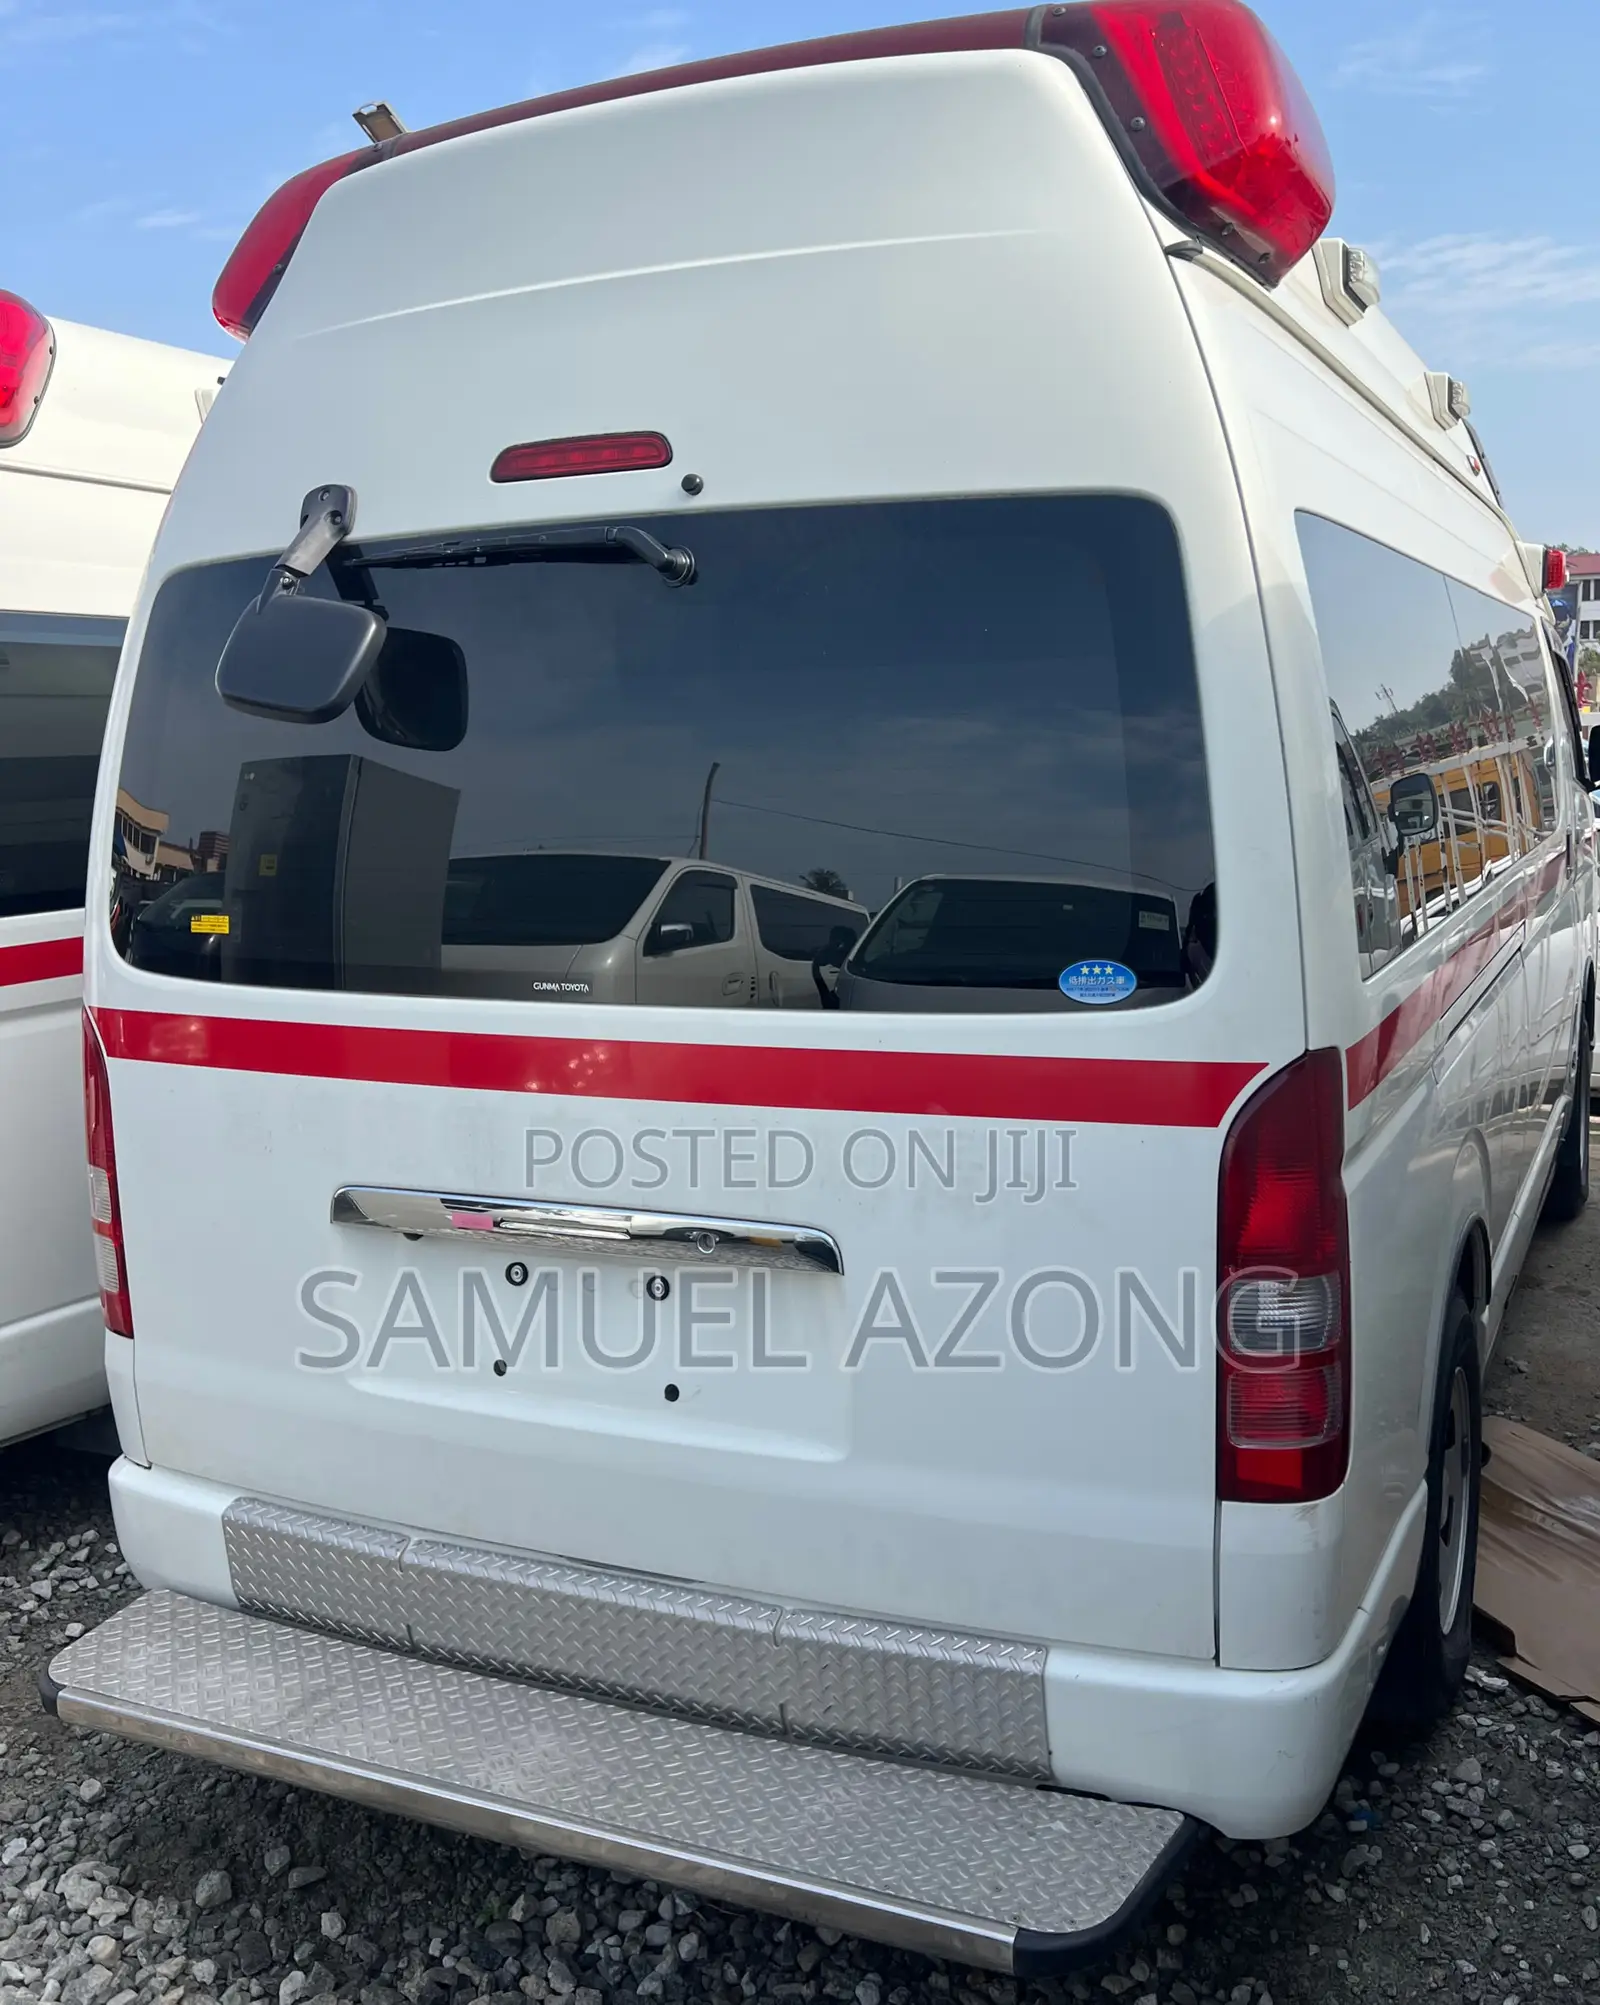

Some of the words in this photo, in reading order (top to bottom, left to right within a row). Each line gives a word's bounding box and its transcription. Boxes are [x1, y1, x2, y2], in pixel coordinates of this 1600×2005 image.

[1068, 975, 1125, 986] 低排出ガス車
[533, 982, 560, 992] GUNMA
[561, 983, 589, 993] TOYOTA
